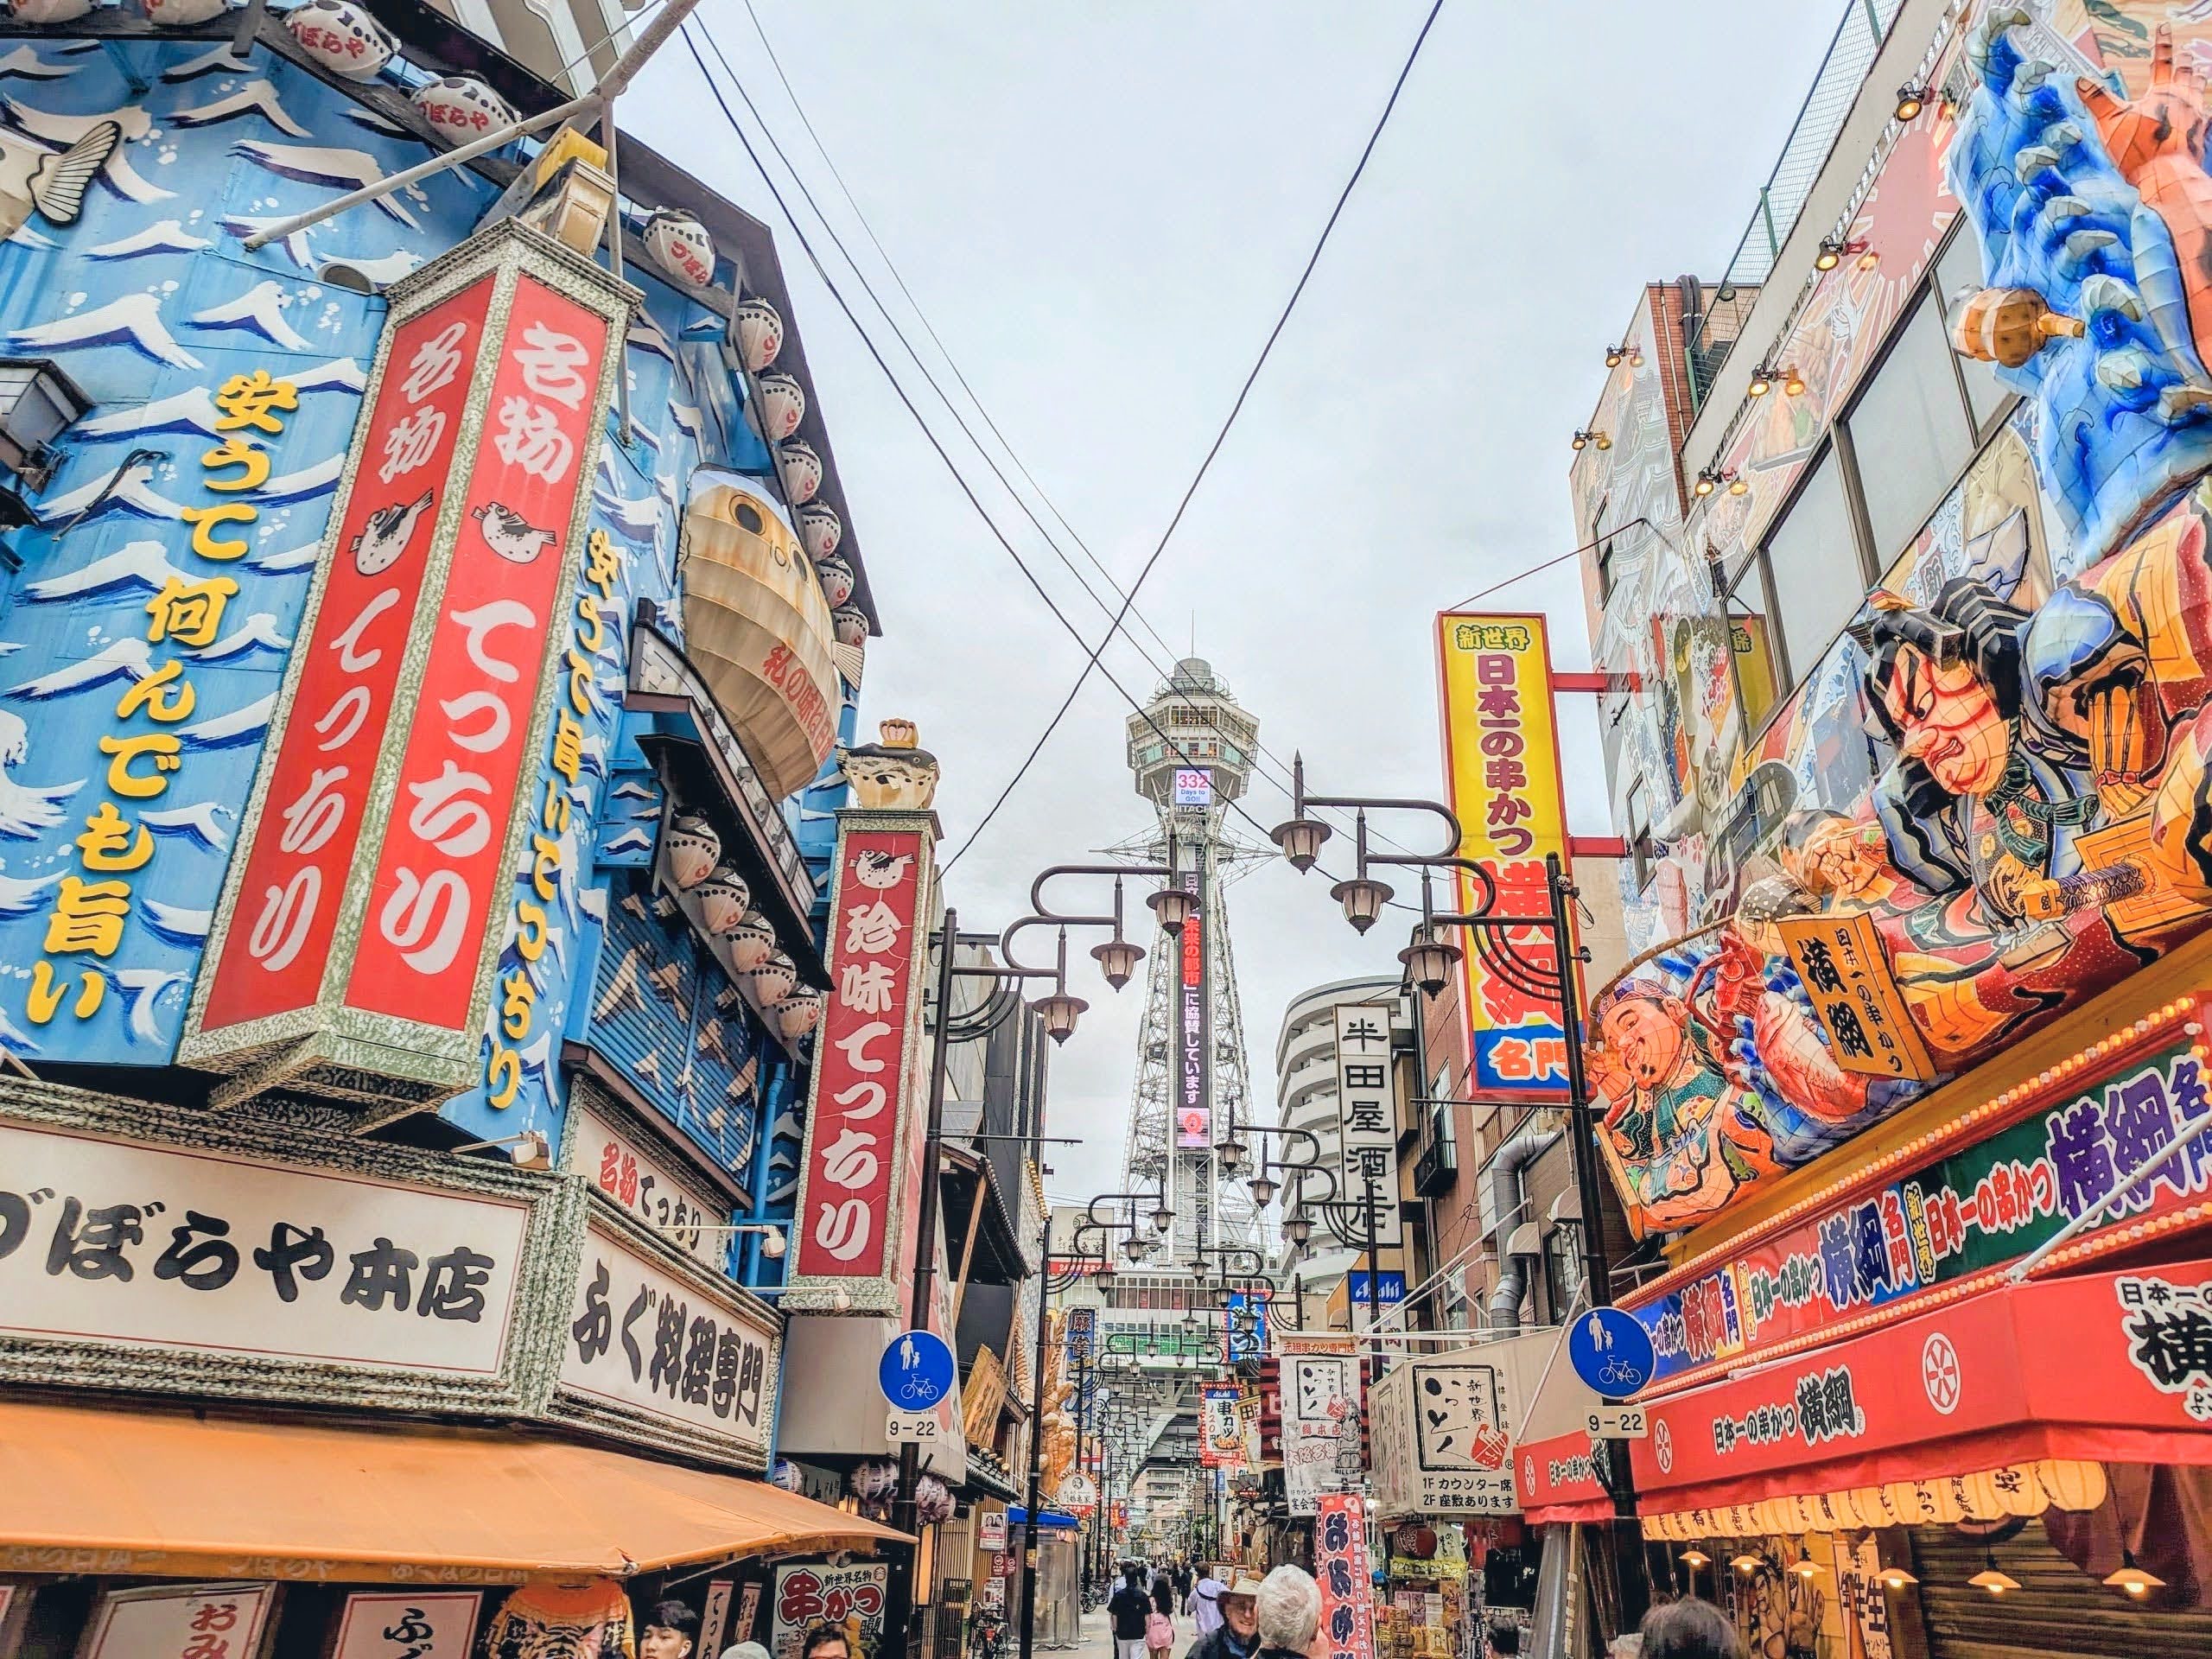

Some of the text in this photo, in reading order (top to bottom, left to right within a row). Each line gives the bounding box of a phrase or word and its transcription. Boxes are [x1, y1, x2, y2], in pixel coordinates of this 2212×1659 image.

[1456, 623, 1530, 652] 新世界
[27, 370, 299, 1025] 安うて何んでも旨い
[1477, 652, 1533, 856] 日本一の串かつ
[250, 588, 400, 972] てっちり
[379, 600, 537, 975] てっちり
[1178, 774, 1208, 788] 332
[1182, 873, 1202, 1105] 日立「未来の都市」に協賛しています
[1472, 858, 1566, 1028] 横綱
[1796, 937, 1875, 1058] 横綱
[1834, 927, 1904, 1073] 日本一の串かつ
[815, 902, 904, 1261] 珍味てっちり
[1491, 1038, 1571, 1080] 名門
[1342, 1018, 1396, 1230] 半田屋酒店
[1904, 1182, 1936, 1282] 新世界
[1926, 1160, 2056, 1255] 日本一の串かつ
[2050, 1071, 2188, 1225] 横綱
[599, 1141, 702, 1251] 名物てっちり
[1355, 1280, 1400, 1299] Aahi
[1751, 1255, 1826, 1321] 日本一の串かつ
[1820, 1200, 1892, 1310] 横綱
[1882, 1192, 1915, 1289] 名門
[1283, 1342, 1357, 1355] 元祖串カツ専門店
[1681, 1276, 1728, 1363] 横綱
[1721, 1269, 1741, 1346] 名門
[1467, 1379, 1487, 1422] 新世界
[1714, 1370, 1855, 1452] 日本一の串かつ 横綱
[1423, 1478, 1512, 1492] 1F カウンター席
[1423, 1495, 1514, 1509] 2F 座敷あります
[779, 1569, 884, 1627] 串かつ
[824, 1570, 873, 1587] 新世界名物
[1325, 1513, 1356, 1659] おみや
